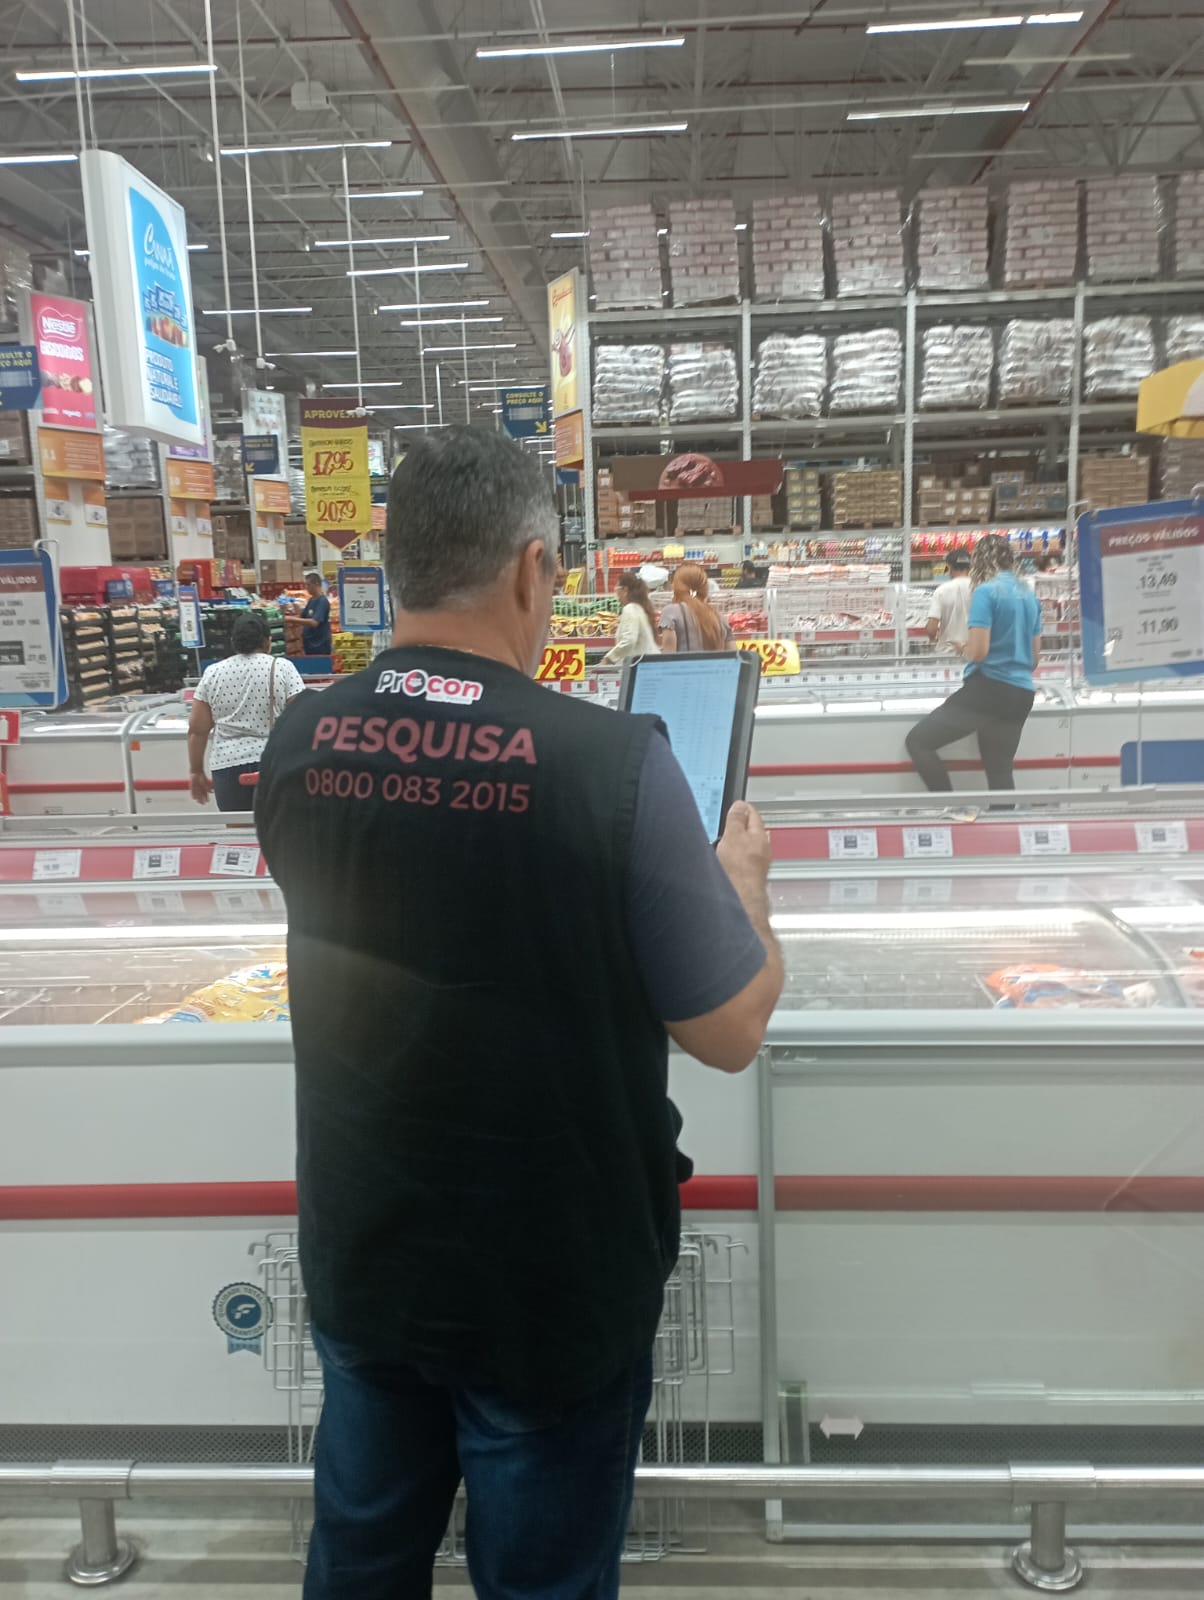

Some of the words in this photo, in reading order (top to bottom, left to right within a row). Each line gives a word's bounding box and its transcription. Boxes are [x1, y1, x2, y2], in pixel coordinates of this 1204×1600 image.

[1108, 531, 1152, 548] PREÇOS
[1152, 526, 1199, 542] VÁLIDOS
[311, 716, 537, 765] PESQUISA
[305, 767, 374, 798] 0800
[382, 773, 442, 806] 083
[449, 779, 531, 813] 2015
